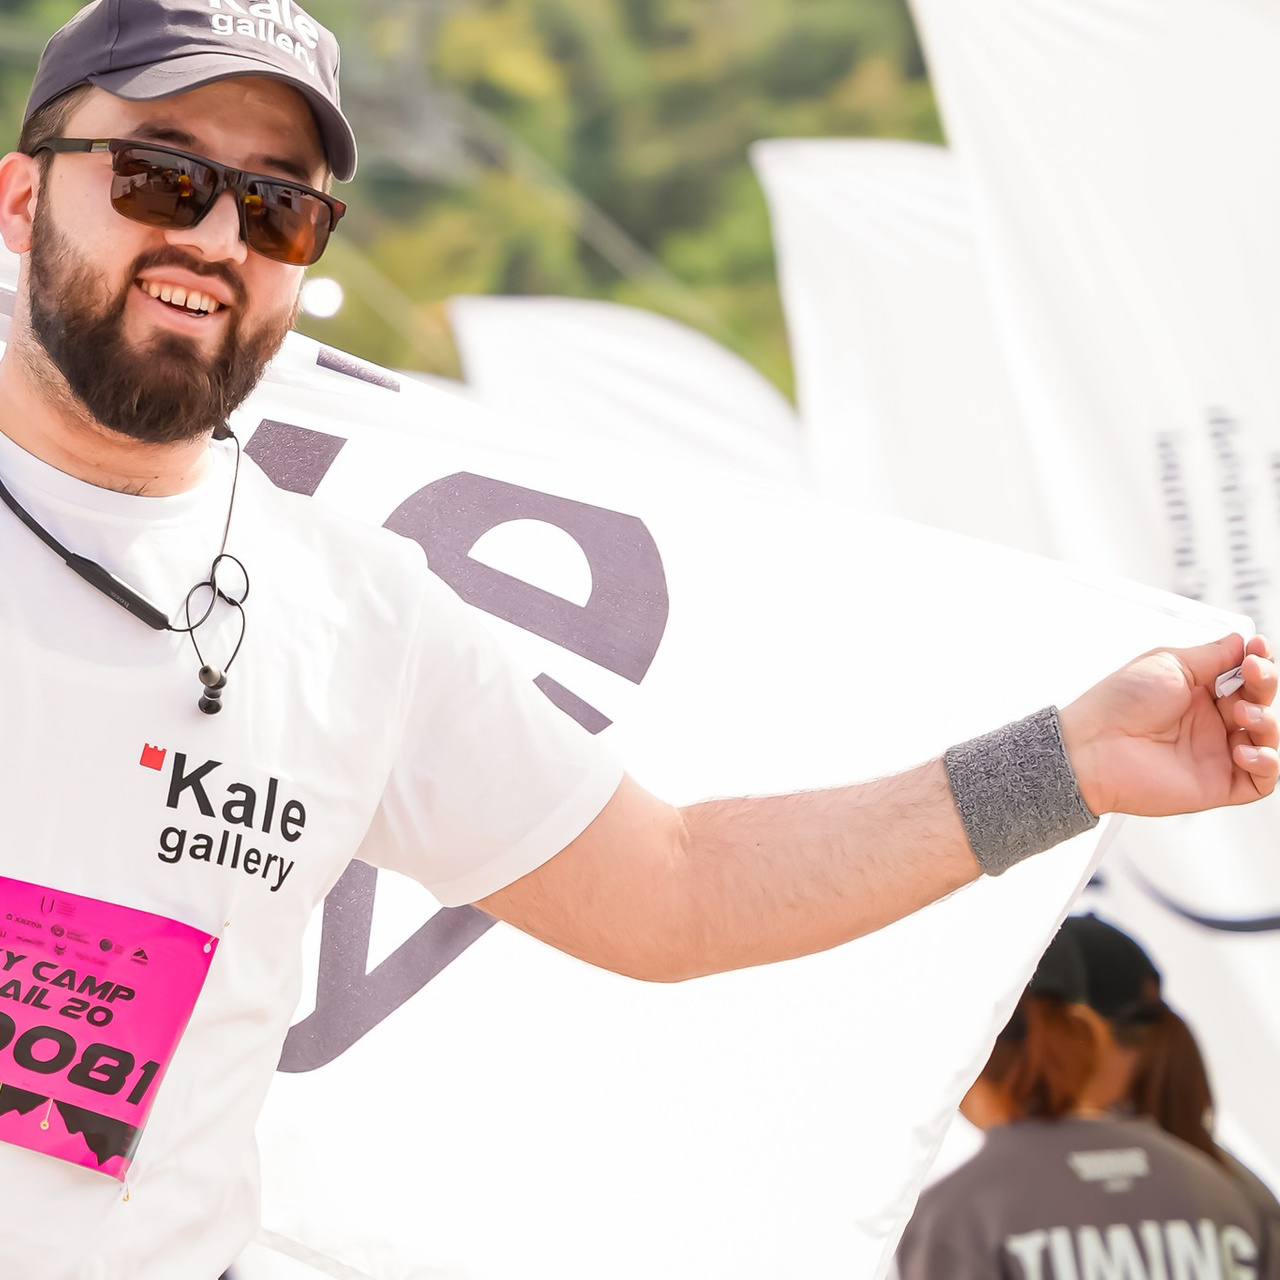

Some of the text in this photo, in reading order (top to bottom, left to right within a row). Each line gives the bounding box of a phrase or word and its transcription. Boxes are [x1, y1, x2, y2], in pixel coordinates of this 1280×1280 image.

[211, 13, 317, 76] gallery
[166, 752, 307, 843] Kale
[157, 826, 295, 892] gallery
[15, 916, 43, 930] xazna
[31, 961, 136, 1004] CAMP
[58, 998, 114, 1027] 20
